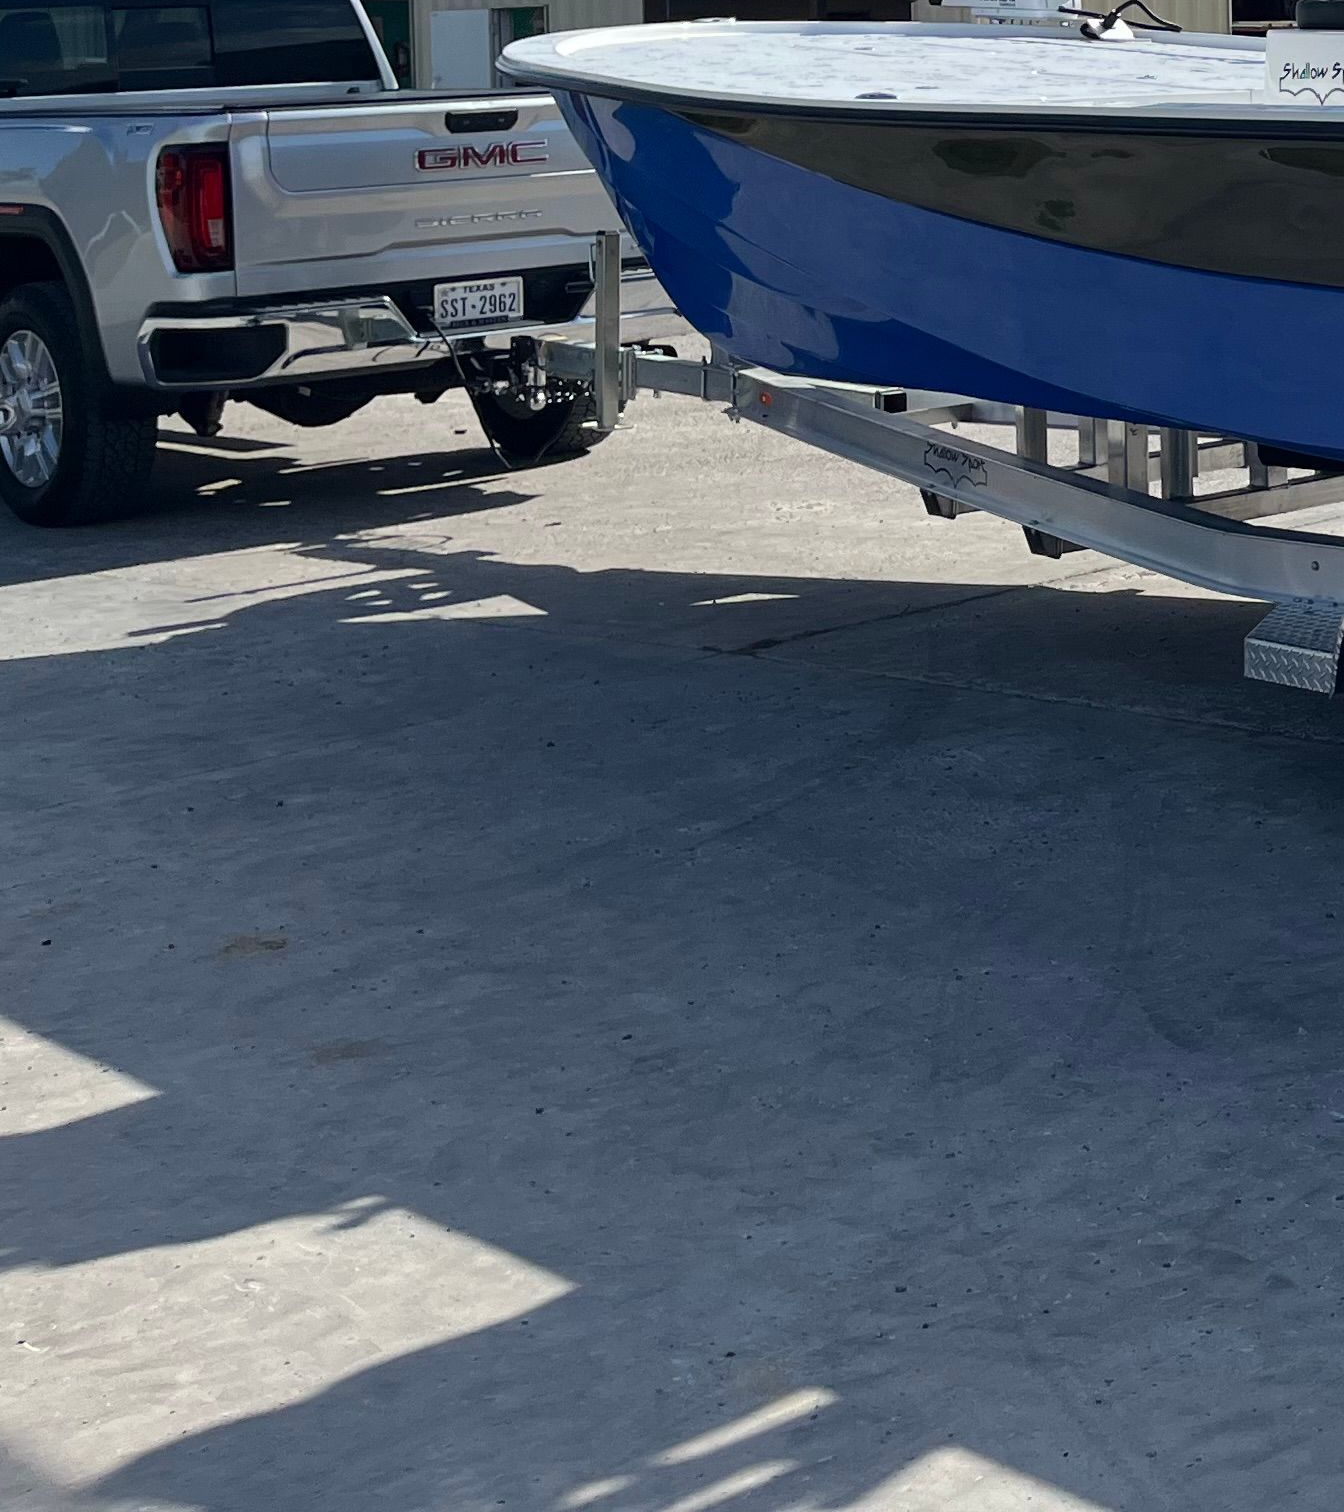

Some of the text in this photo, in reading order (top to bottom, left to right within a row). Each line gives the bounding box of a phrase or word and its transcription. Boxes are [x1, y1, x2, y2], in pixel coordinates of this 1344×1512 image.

[1281, 62, 1329, 80] Shallow
[415, 138, 549, 172] GMC
[463, 283, 496, 294] TEXAS
